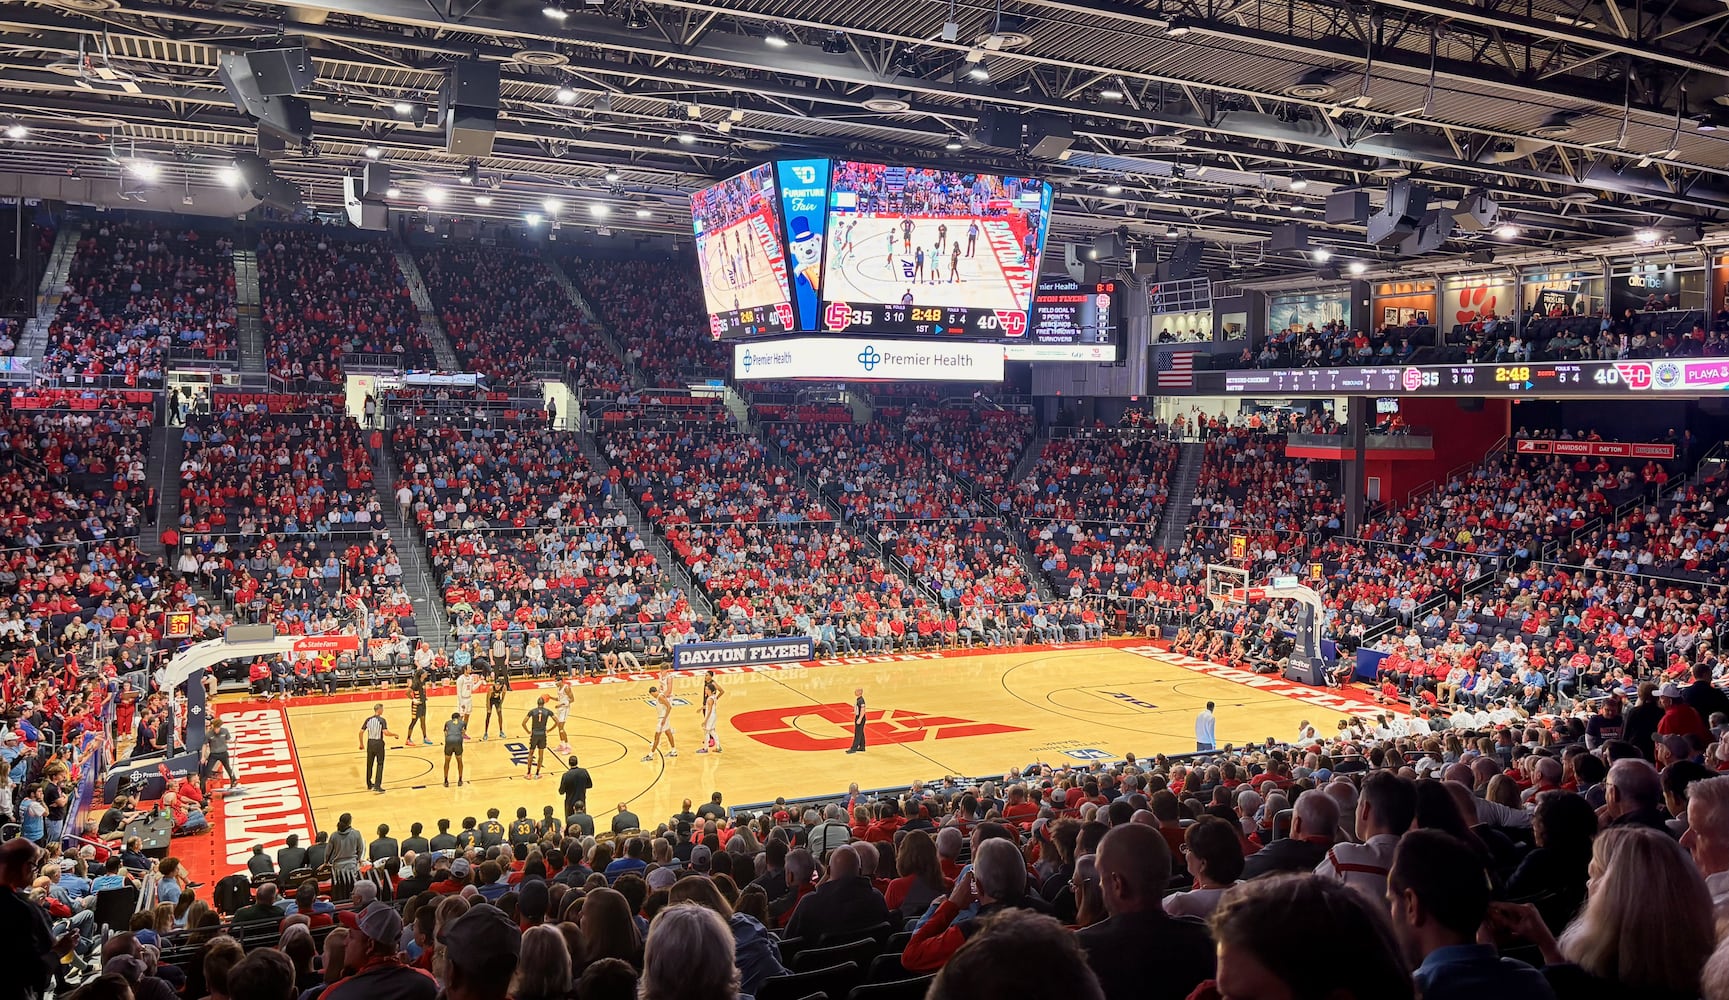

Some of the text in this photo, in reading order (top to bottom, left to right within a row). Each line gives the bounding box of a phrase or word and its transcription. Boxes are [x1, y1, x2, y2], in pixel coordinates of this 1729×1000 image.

[783, 188, 825, 198] FURNITURE
[792, 197, 817, 211] Fair
[1054, 282, 1078, 290] Health
[1628, 275, 1664, 288] altafiber
[851, 310, 872, 325] 35
[884, 312, 904, 322] 3 10
[911, 308, 942, 322] 2:48
[949, 314, 966, 324] 5 4
[977, 316, 997, 330] 40
[752, 352, 792, 366] Premier Health
[884, 352, 973, 366] Premier Health
[1422, 372, 1440, 386] 35
[1452, 375, 1474, 384] 3 10
[1496, 367, 1530, 381] 2:48
[1560, 373, 1580, 382] 5 4
[1594, 369, 1619, 384] 40
[1689, 368, 1720, 380] PLAYA
[1556, 443, 1588, 451] DAVIDSON
[170, 624, 186, 634] 30
[680, 644, 809, 665] DAYTON FLYERS
[819, 652, 944, 666] COURT
[1121, 645, 1289, 687] DAYTON
[223, 778, 311, 884] AYTON
[488, 824, 500, 834] 23
[518, 824, 530, 834] 33
[468, 836, 475, 846] 2
